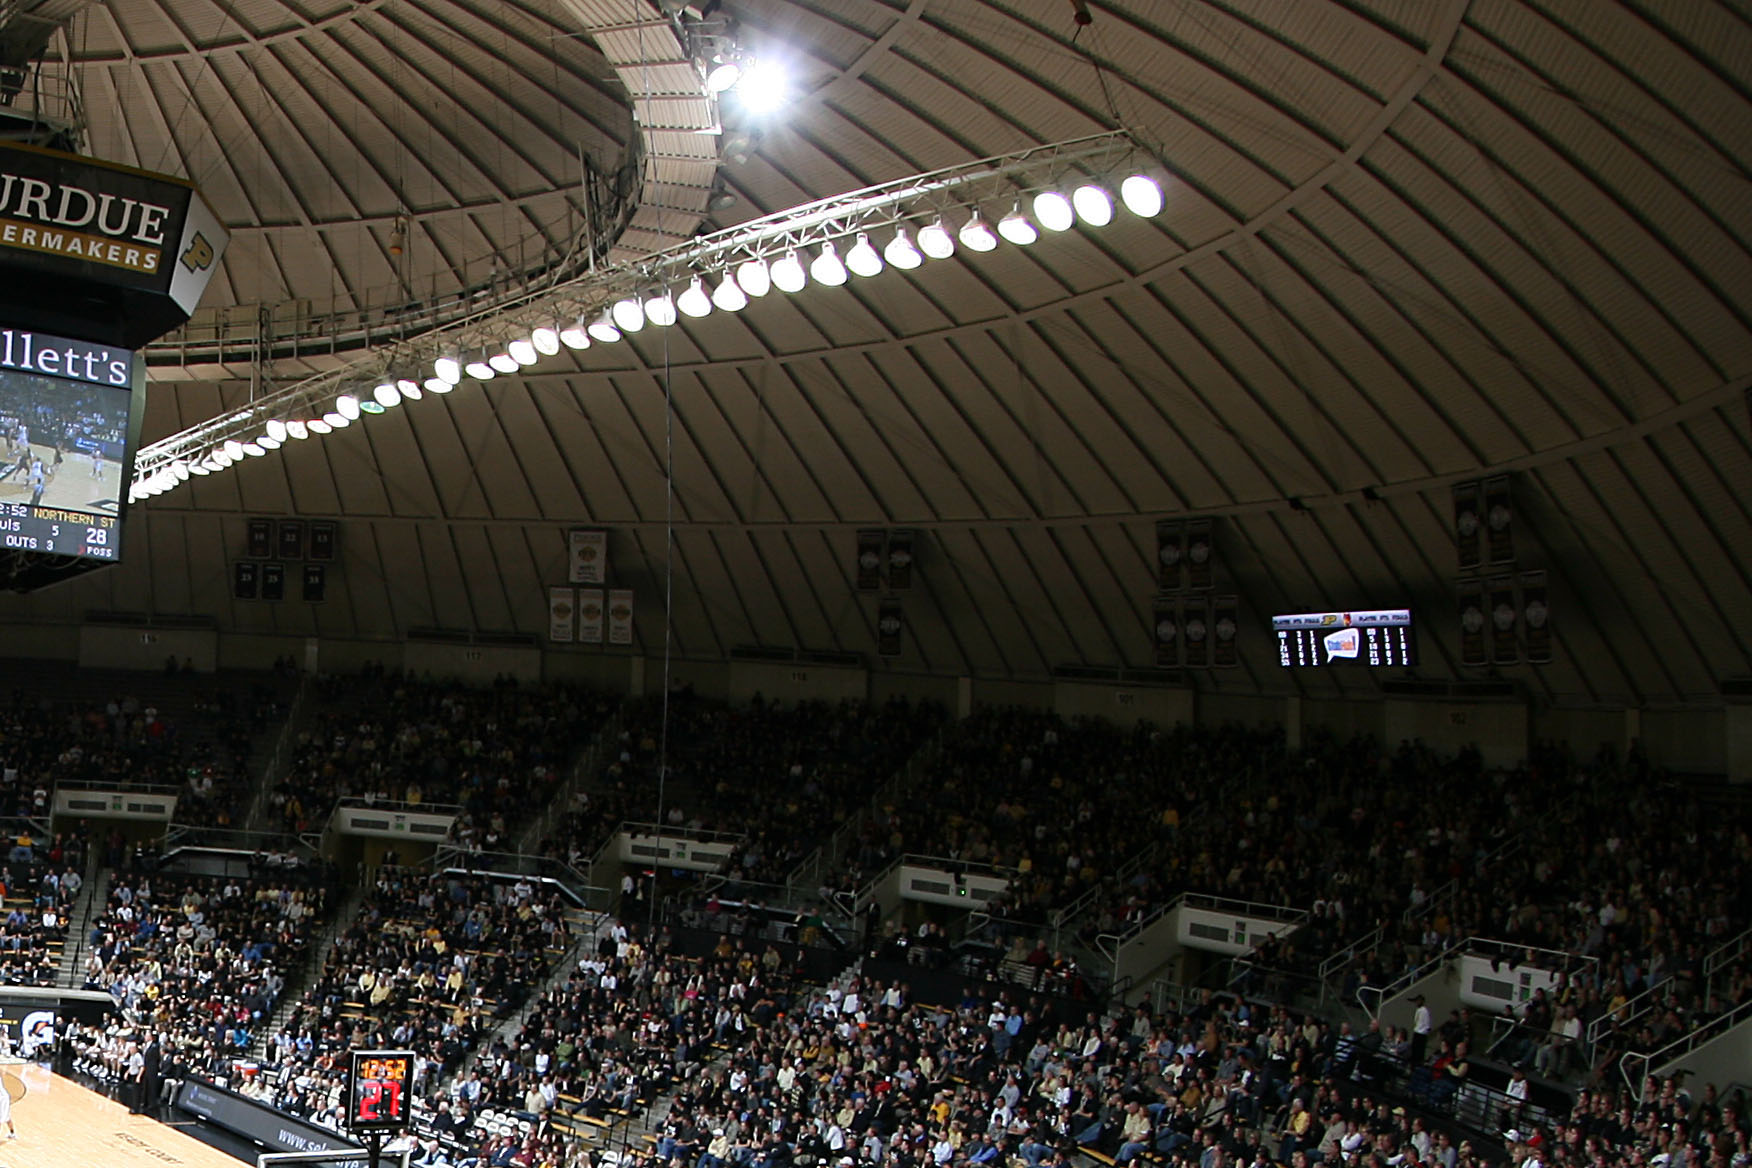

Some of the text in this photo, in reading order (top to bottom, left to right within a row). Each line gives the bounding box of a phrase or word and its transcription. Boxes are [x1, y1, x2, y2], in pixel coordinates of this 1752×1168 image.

[33, 507, 117, 529] NORTHERN ST
[51, 525, 60, 537] 5
[86, 527, 108, 545] 28
[6, 534, 38, 550] OUTS
[46, 539, 55, 551] 3
[87, 545, 113, 558] POSS
[359, 1058, 406, 1080] 12:52
[359, 1081, 401, 1120] 27
